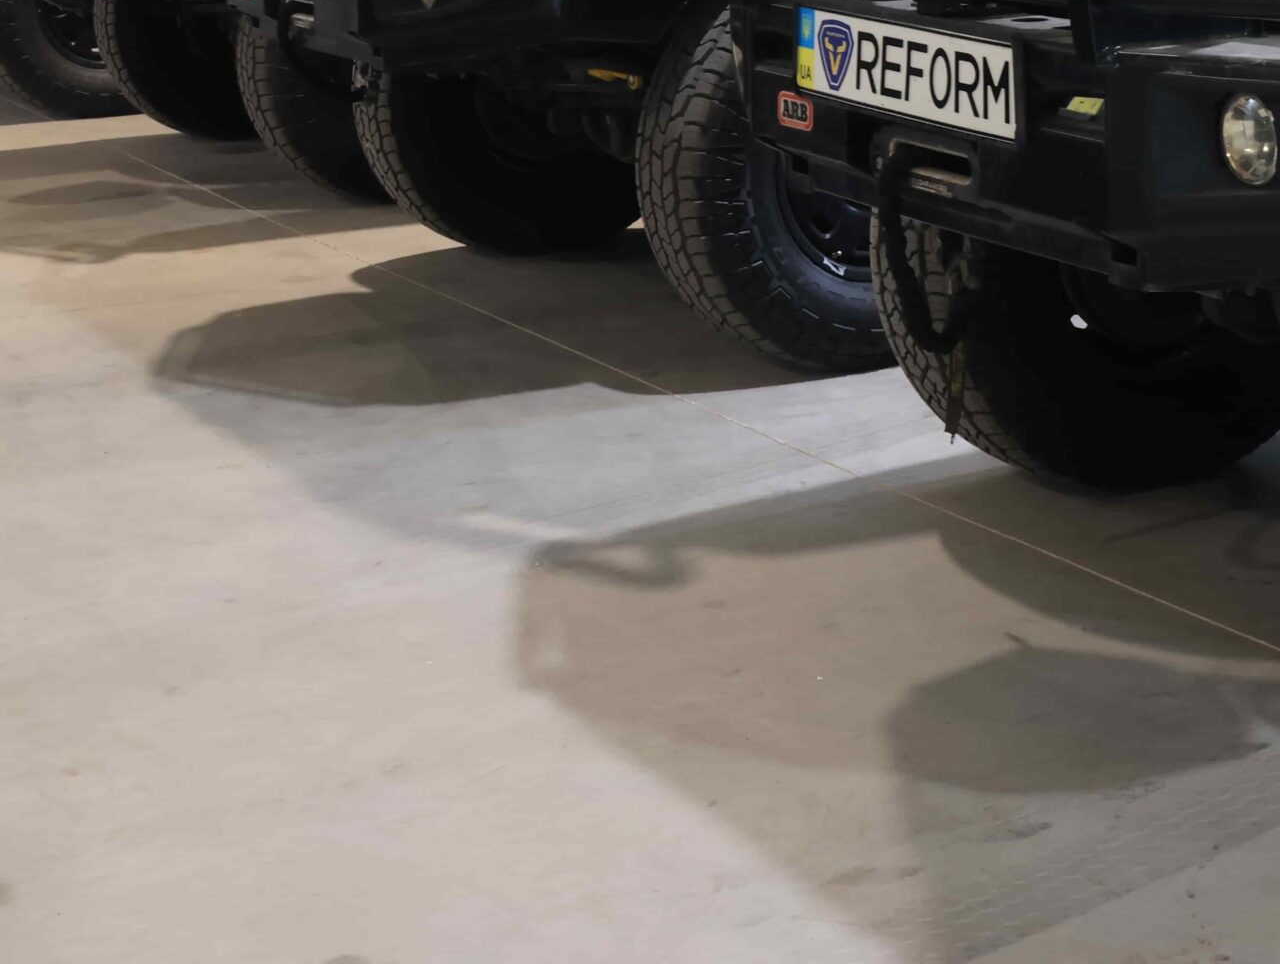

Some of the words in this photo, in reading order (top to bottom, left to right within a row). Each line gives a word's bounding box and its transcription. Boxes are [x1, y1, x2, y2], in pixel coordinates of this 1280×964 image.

[799, 64, 812, 81] UA
[855, 30, 1011, 125] REFORM
[782, 98, 809, 123] ARB
